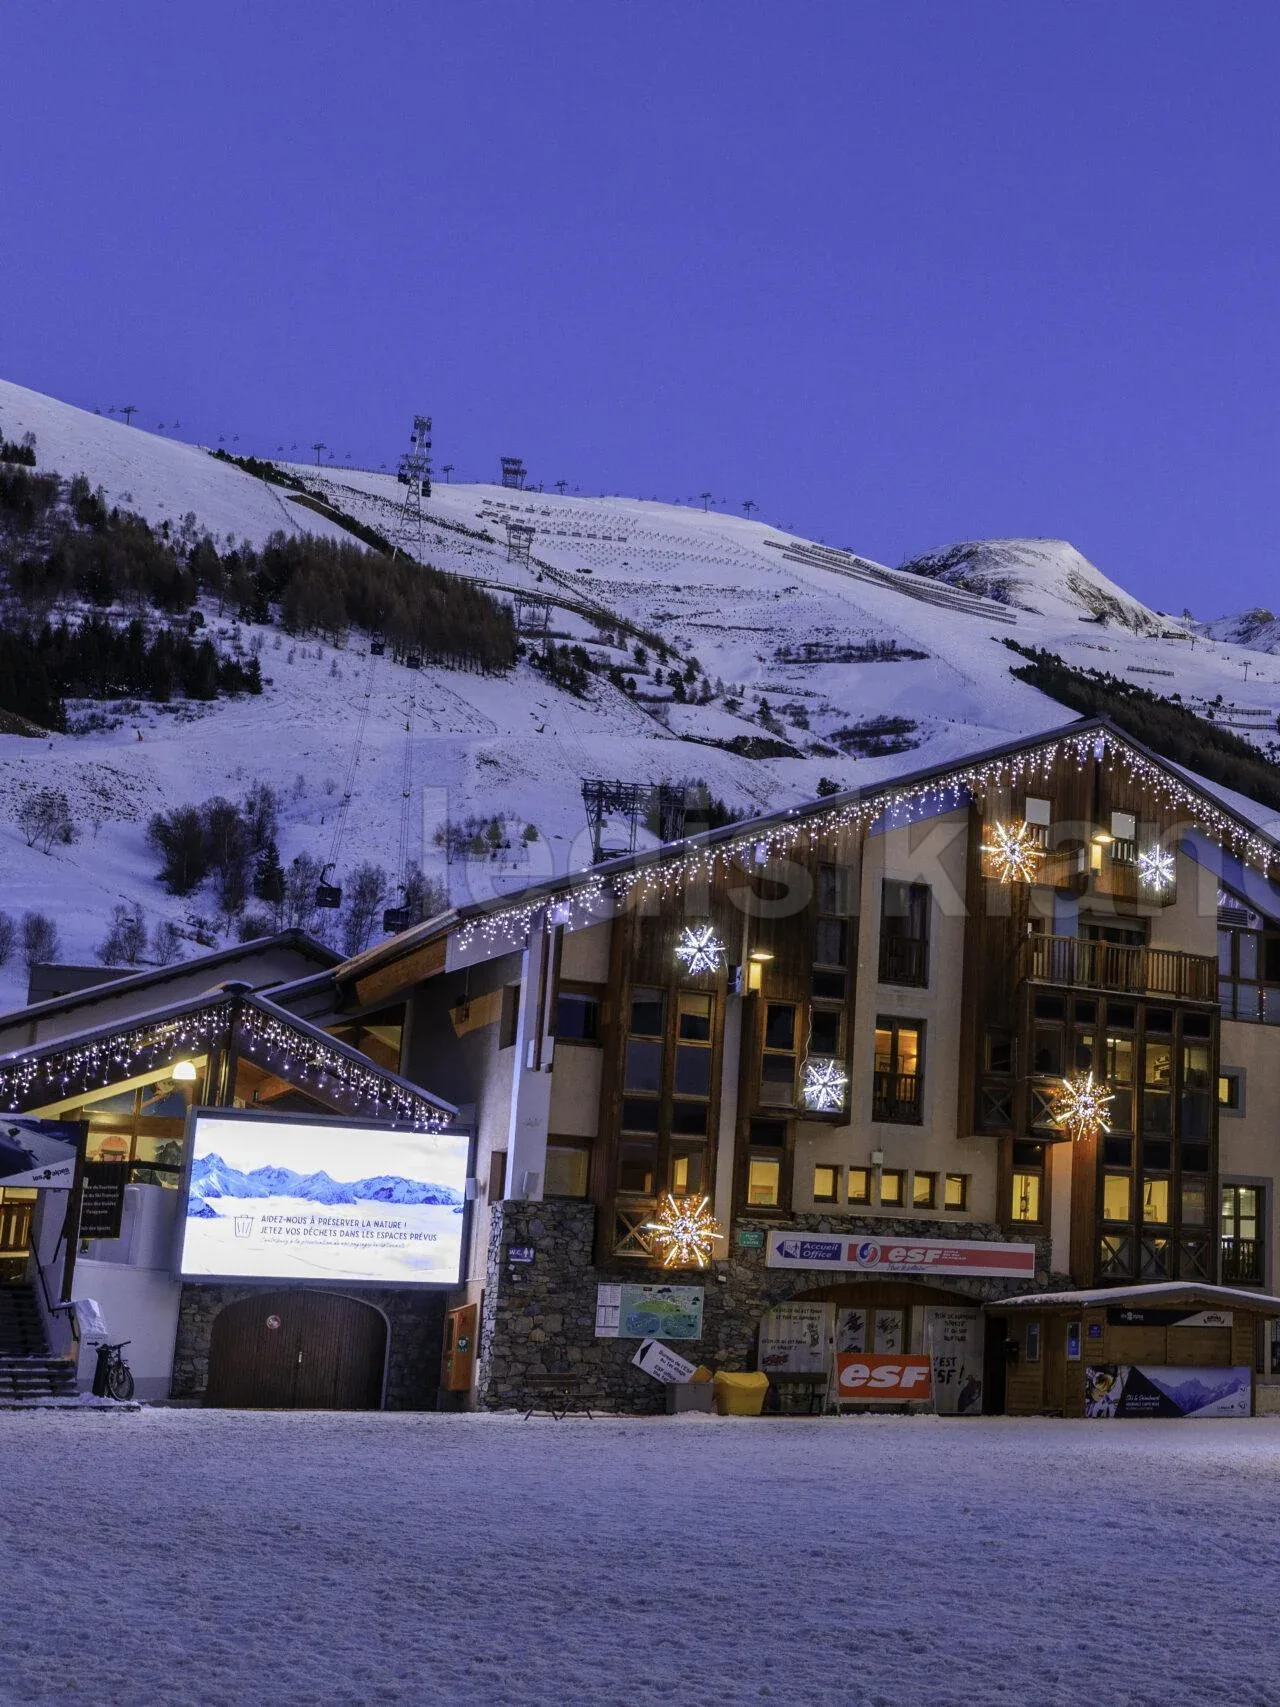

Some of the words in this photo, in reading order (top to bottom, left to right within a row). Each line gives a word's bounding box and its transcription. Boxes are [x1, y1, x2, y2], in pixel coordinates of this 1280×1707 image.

[261, 1215, 307, 1225] AIDEZ-NOUS
[318, 1216, 360, 1227] PRÉSERVER
[362, 1219, 371, 1228] LA
[373, 1220, 401, 1229] NATURE
[260, 1226, 282, 1235] JETEZ
[285, 1227, 300, 1236] VOS
[303, 1228, 337, 1238] DÉCHETS
[340, 1230, 360, 1238] DANS
[362, 1230, 374, 1239] LES
[377, 1231, 407, 1240] ESPACES
[410, 1231, 437, 1241] PRÉVUS
[802, 1242, 838, 1251] Accueil
[802, 1250, 832, 1259] Office
